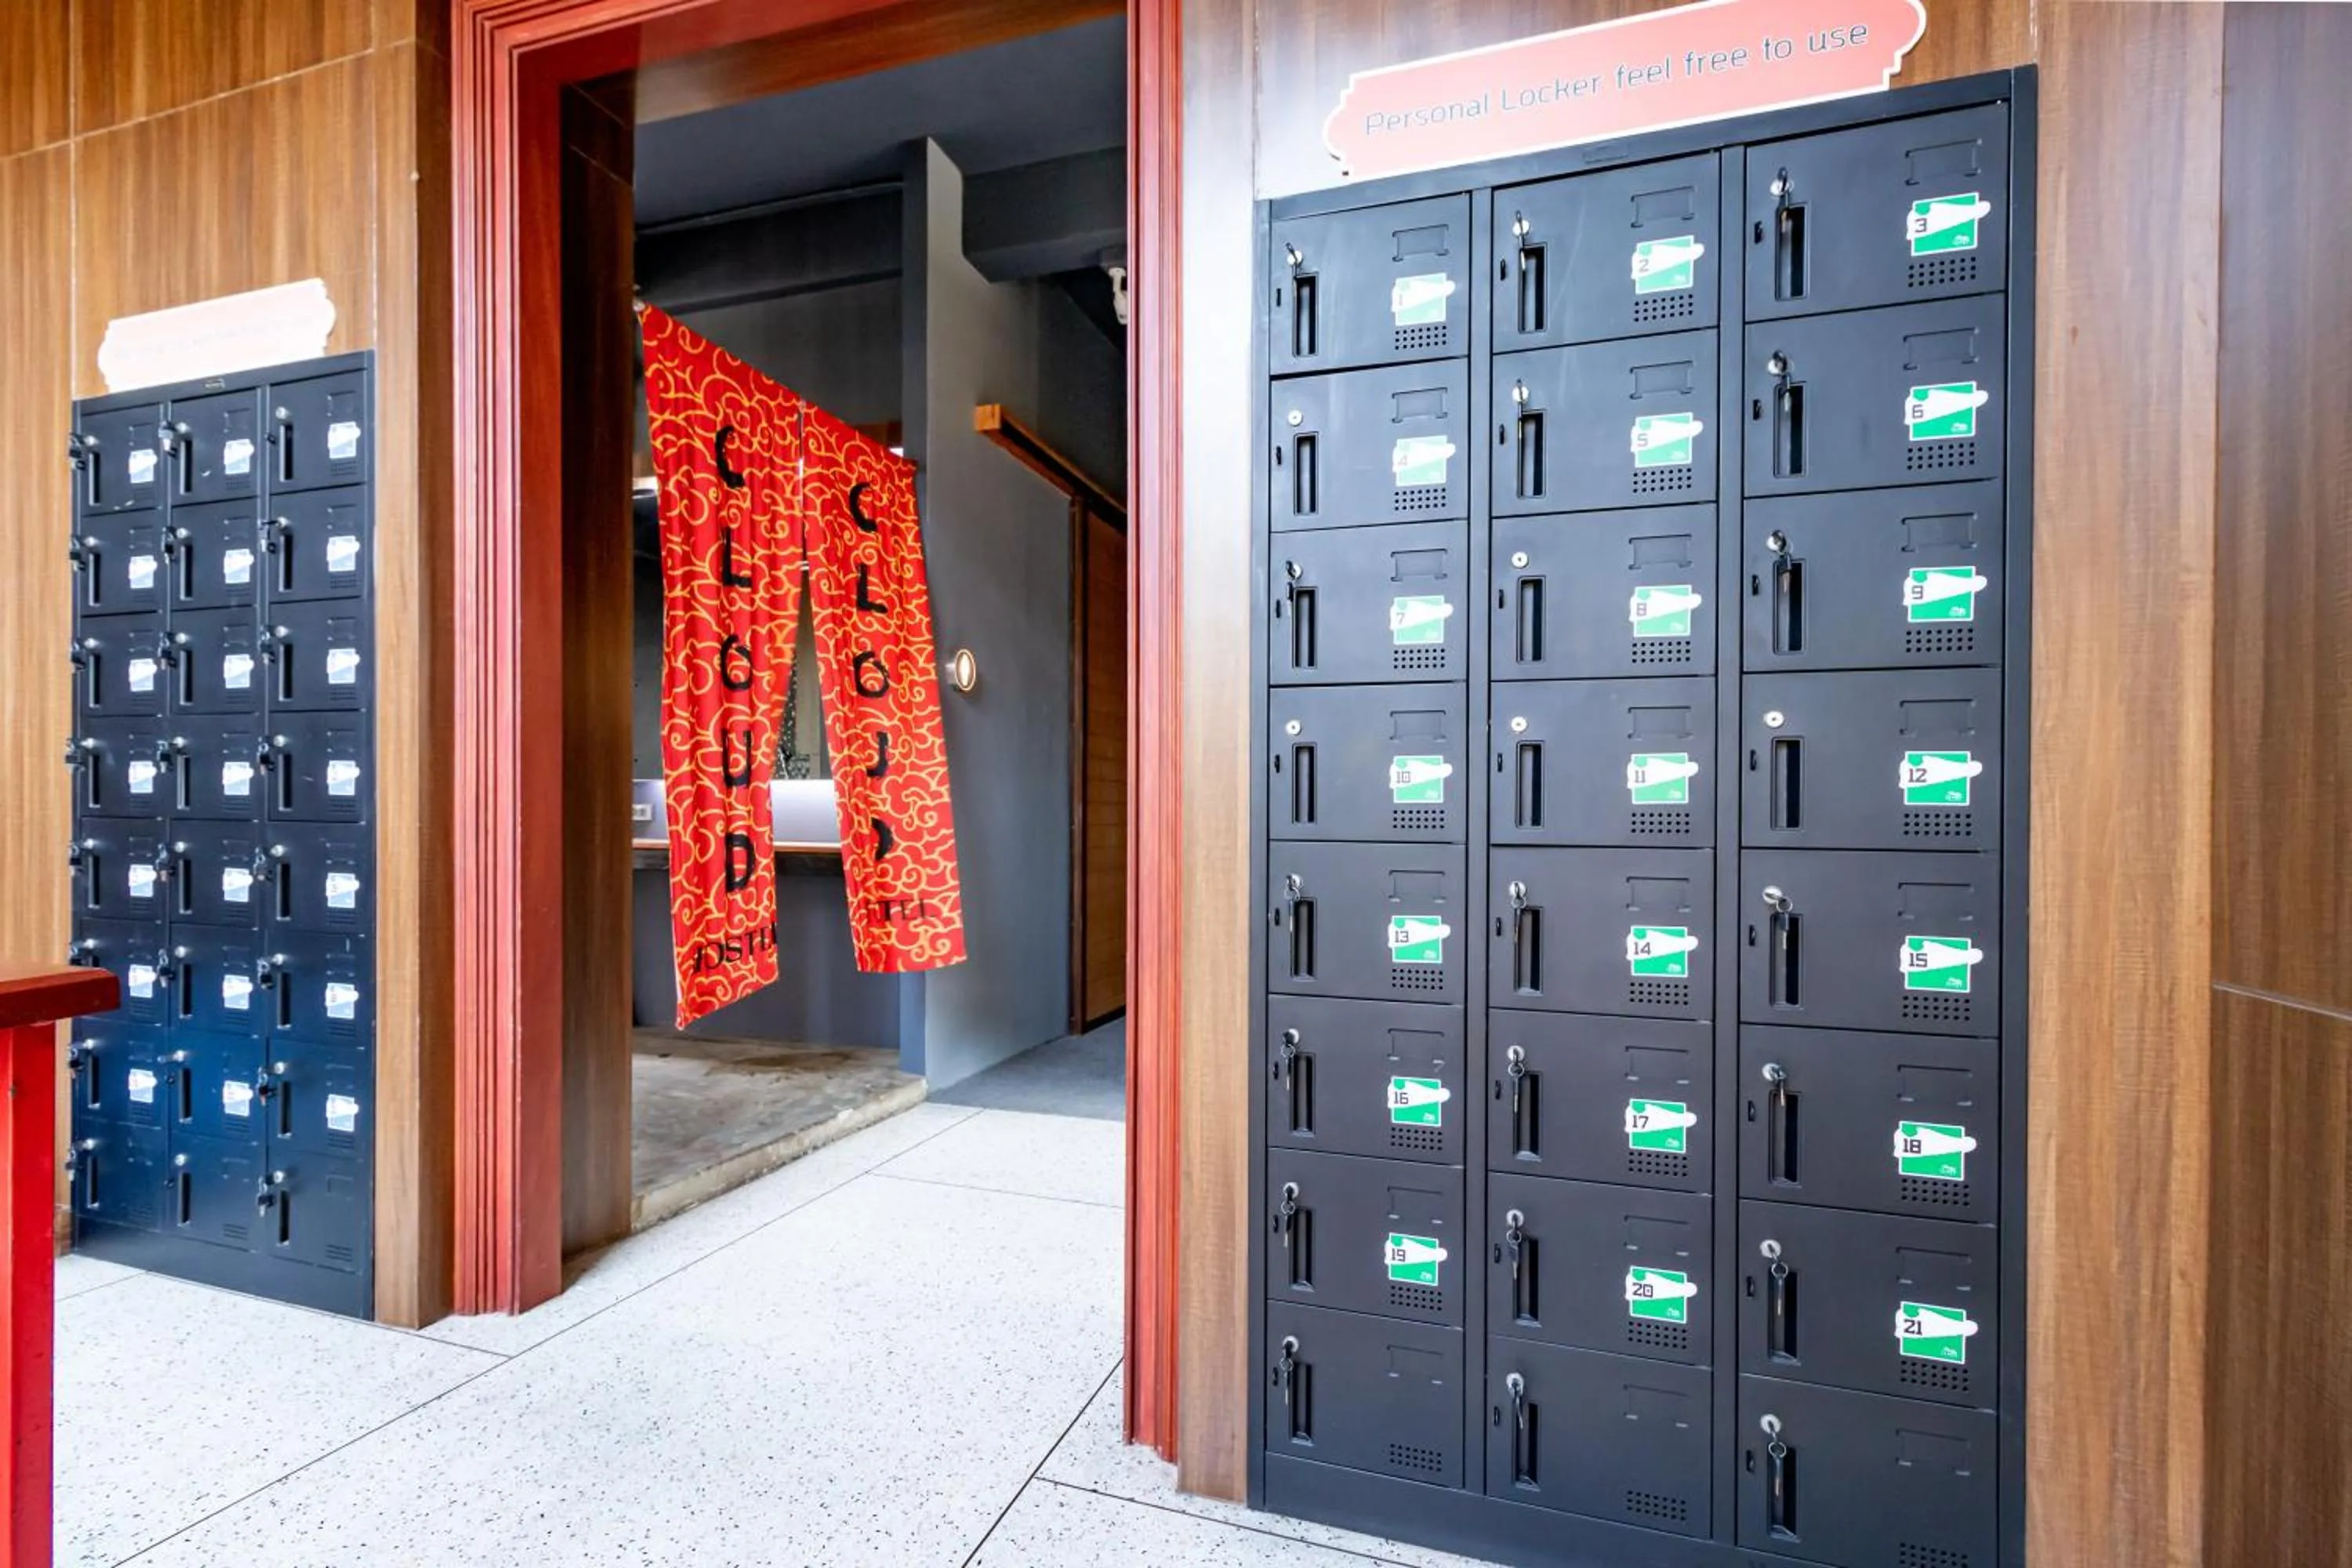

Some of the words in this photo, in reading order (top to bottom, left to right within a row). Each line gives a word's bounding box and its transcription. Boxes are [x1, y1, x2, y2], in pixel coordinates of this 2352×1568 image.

[1366, 93, 1488, 135] Personal
[1501, 76, 1602, 111] Locker
[1615, 57, 1670, 89] feel
[1684, 48, 1748, 75] free
[1763, 38, 1792, 60] to
[1808, 24, 1867, 53] use
[1915, 219, 1927, 233] 3
[1639, 259, 1650, 272] 2
[1912, 405, 1923, 419] 6
[1638, 433, 1647, 447] 5
[1912, 586, 1922, 599] 9
[1637, 603, 1646, 616] 8
[1396, 612, 1405, 625] 7
[715, 425, 757, 892] CLOUD
[1396, 771, 1410, 782] 10
[1634, 771, 1646, 783] 11
[1908, 768, 1926, 782] 12
[1395, 931, 1409, 943] 13
[1633, 942, 1651, 955] 14
[1909, 953, 1927, 967] 15
[1394, 1092, 1408, 1104] 16
[1632, 1116, 1648, 1128] 17
[1903, 1139, 1921, 1153] 18
[1392, 1249, 1405, 1261] 19
[1632, 1283, 1653, 1297] 20
[1904, 1318, 1922, 1334] 21
